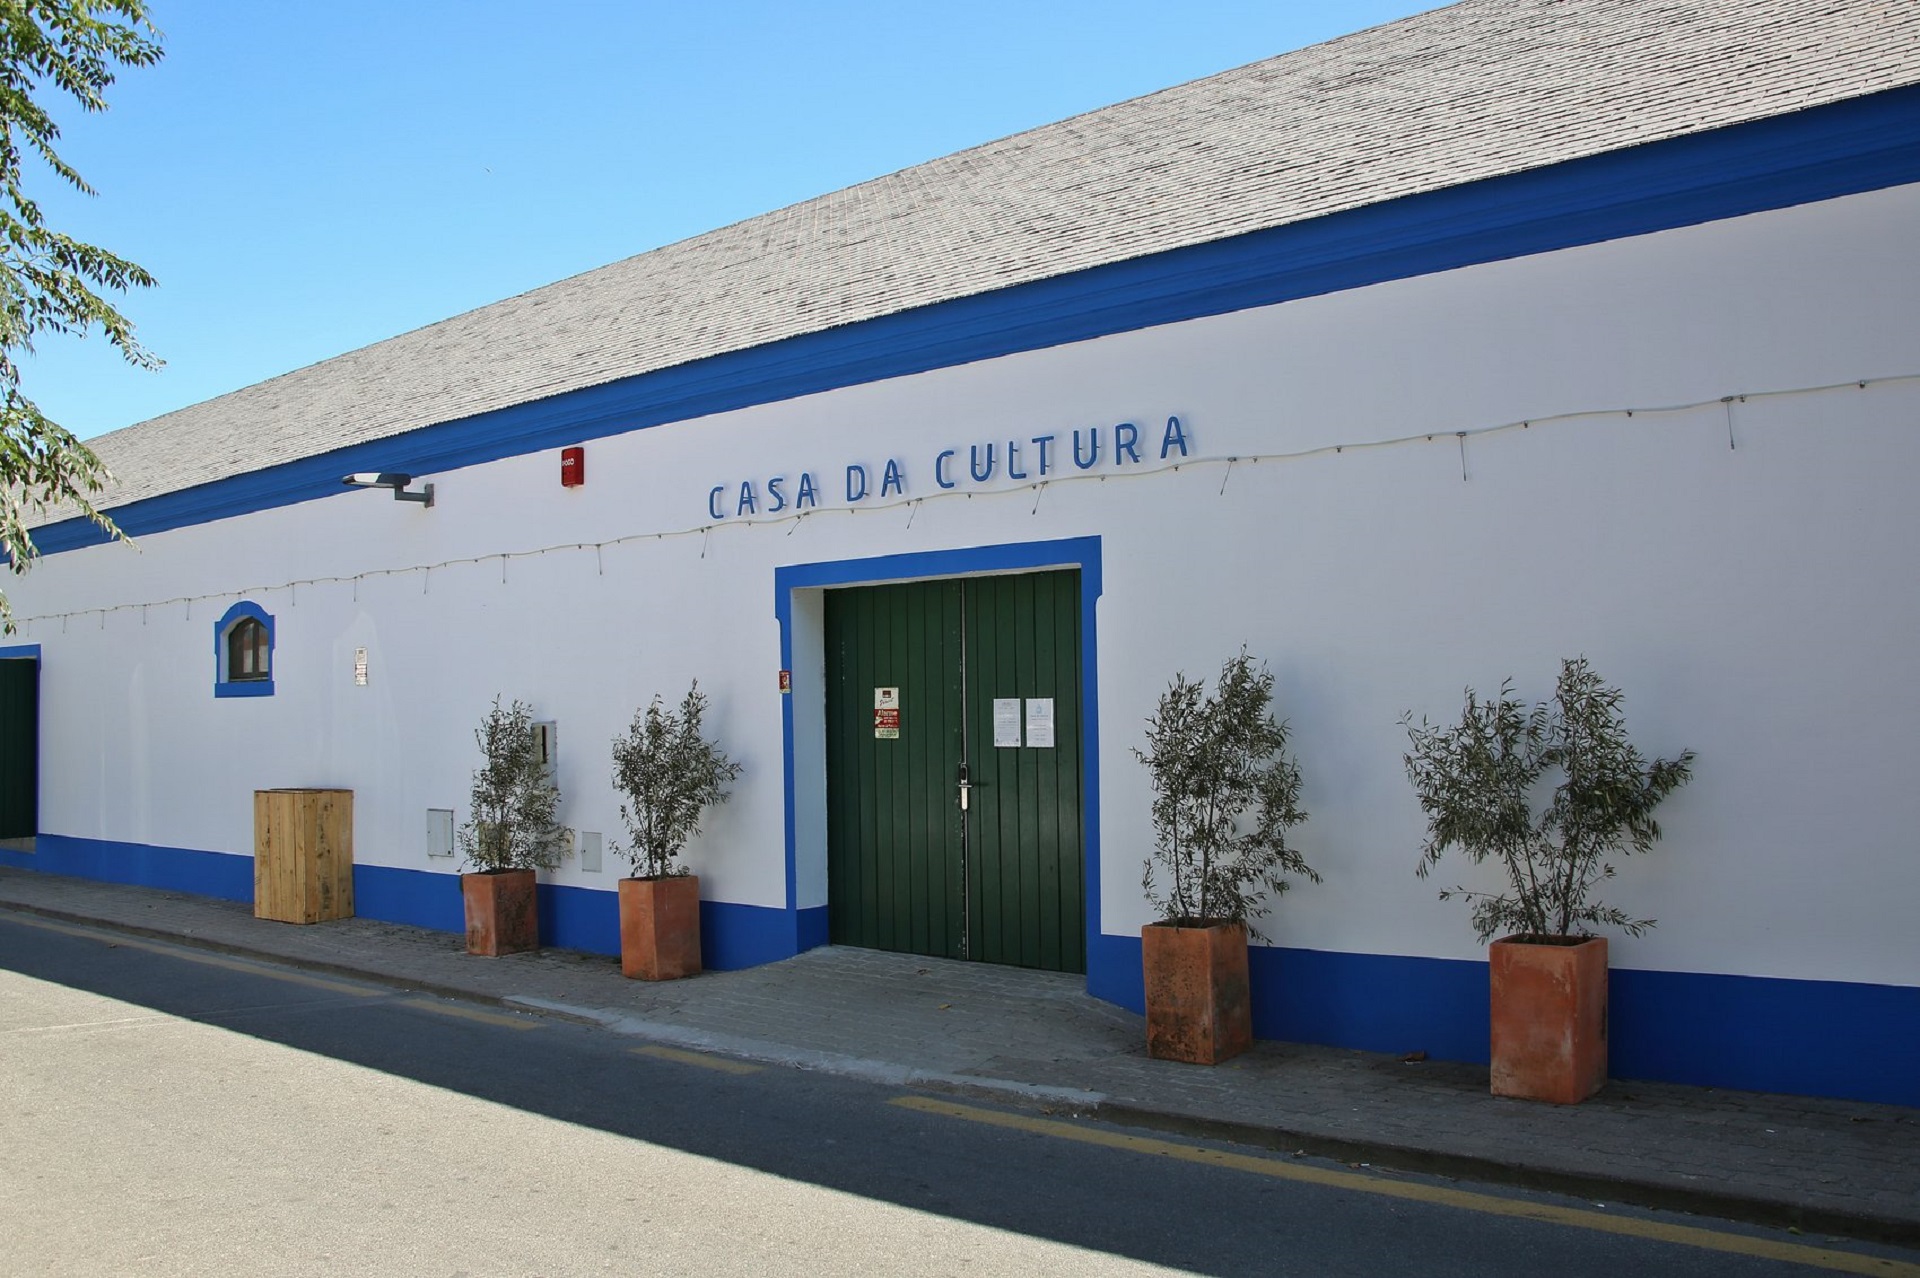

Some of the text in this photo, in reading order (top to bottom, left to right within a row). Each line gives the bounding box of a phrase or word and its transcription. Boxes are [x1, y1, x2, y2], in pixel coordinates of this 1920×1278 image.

[709, 416, 1187, 519] CASA DA CULTURA
